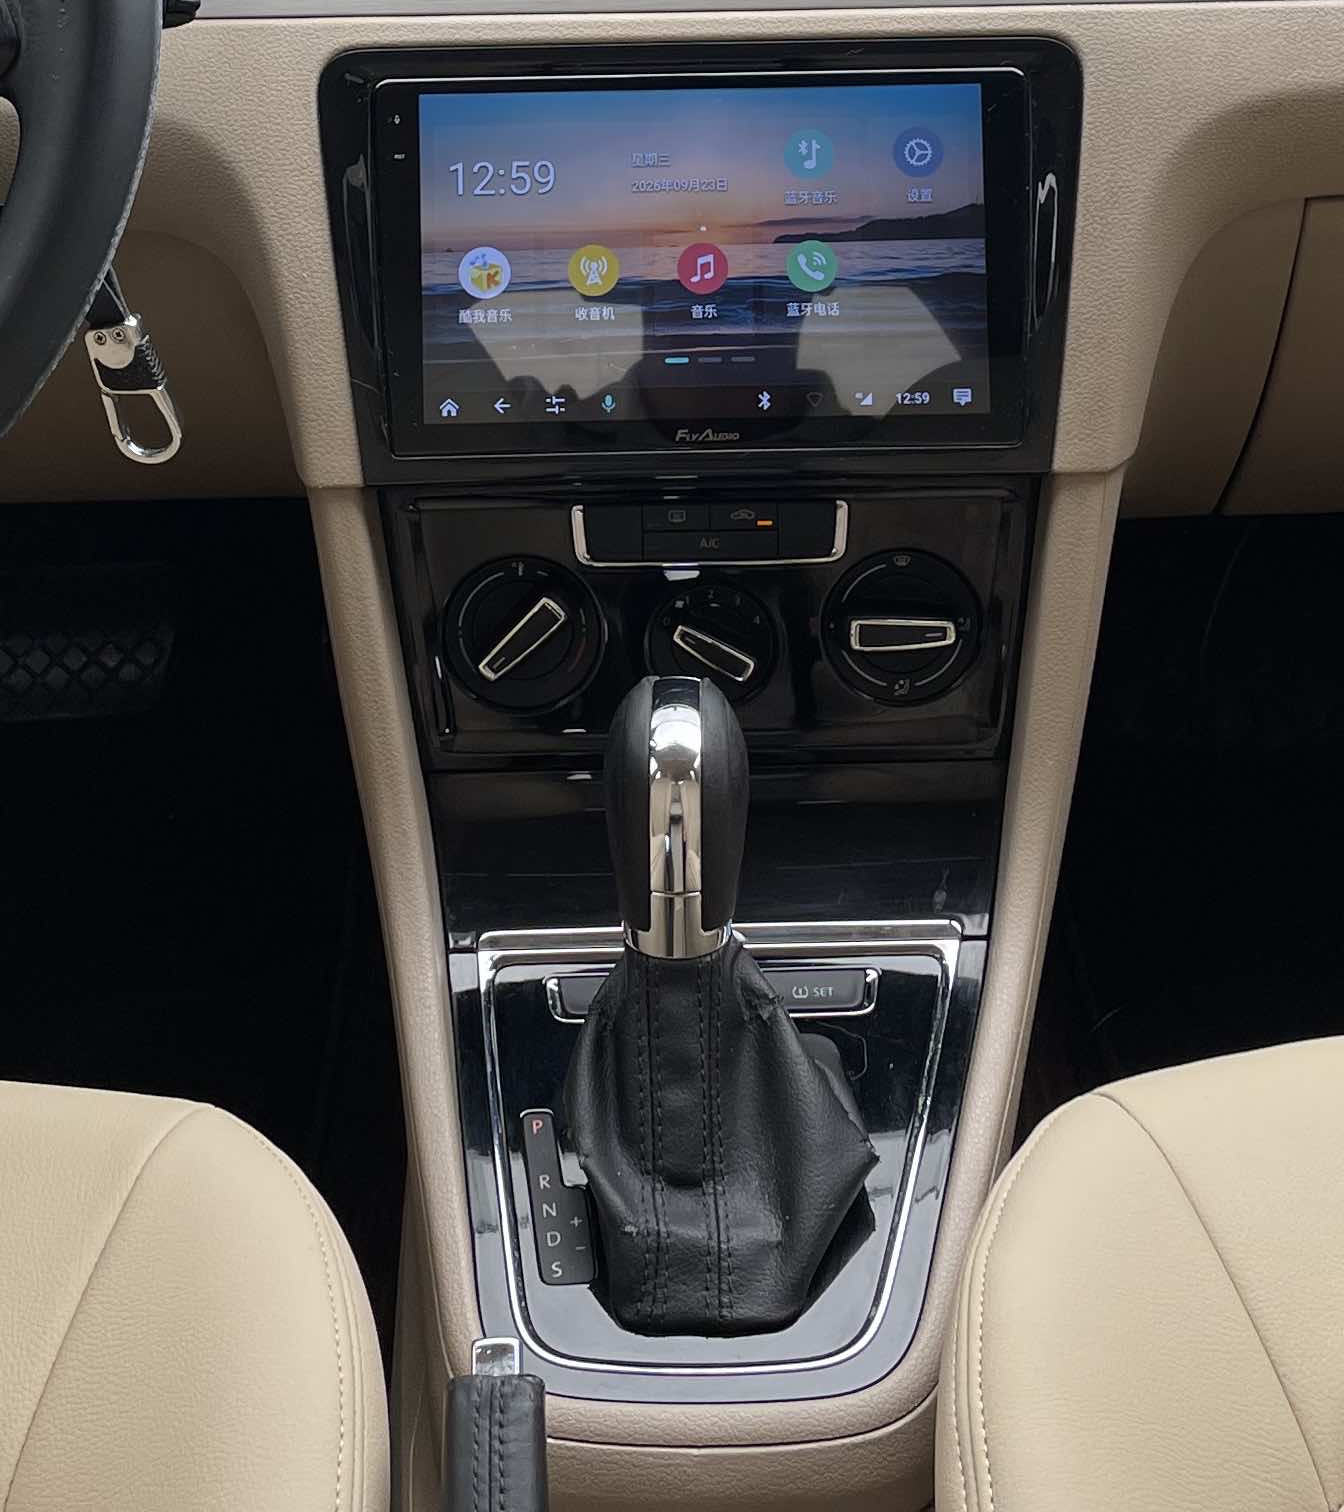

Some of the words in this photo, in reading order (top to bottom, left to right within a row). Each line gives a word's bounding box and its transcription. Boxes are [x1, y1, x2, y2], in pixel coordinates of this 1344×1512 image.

[449, 160, 556, 196] 12:59
[784, 190, 837, 206] 蓝牙音乐
[907, 188, 933, 203] 设置
[458, 309, 513, 324] 酷我音乐
[575, 307, 615, 321] 收音机
[690, 304, 718, 319] 音乐
[786, 302, 840, 317] 蓝牙电话
[895, 392, 930, 405] 12:59
[699, 538, 721, 549] A/C
[812, 987, 833, 998] SET
[532, 1119, 543, 1135] P
[539, 1174, 551, 1189] R
[542, 1202, 556, 1218] N
[547, 1231, 561, 1247] D
[551, 1261, 563, 1277] S
